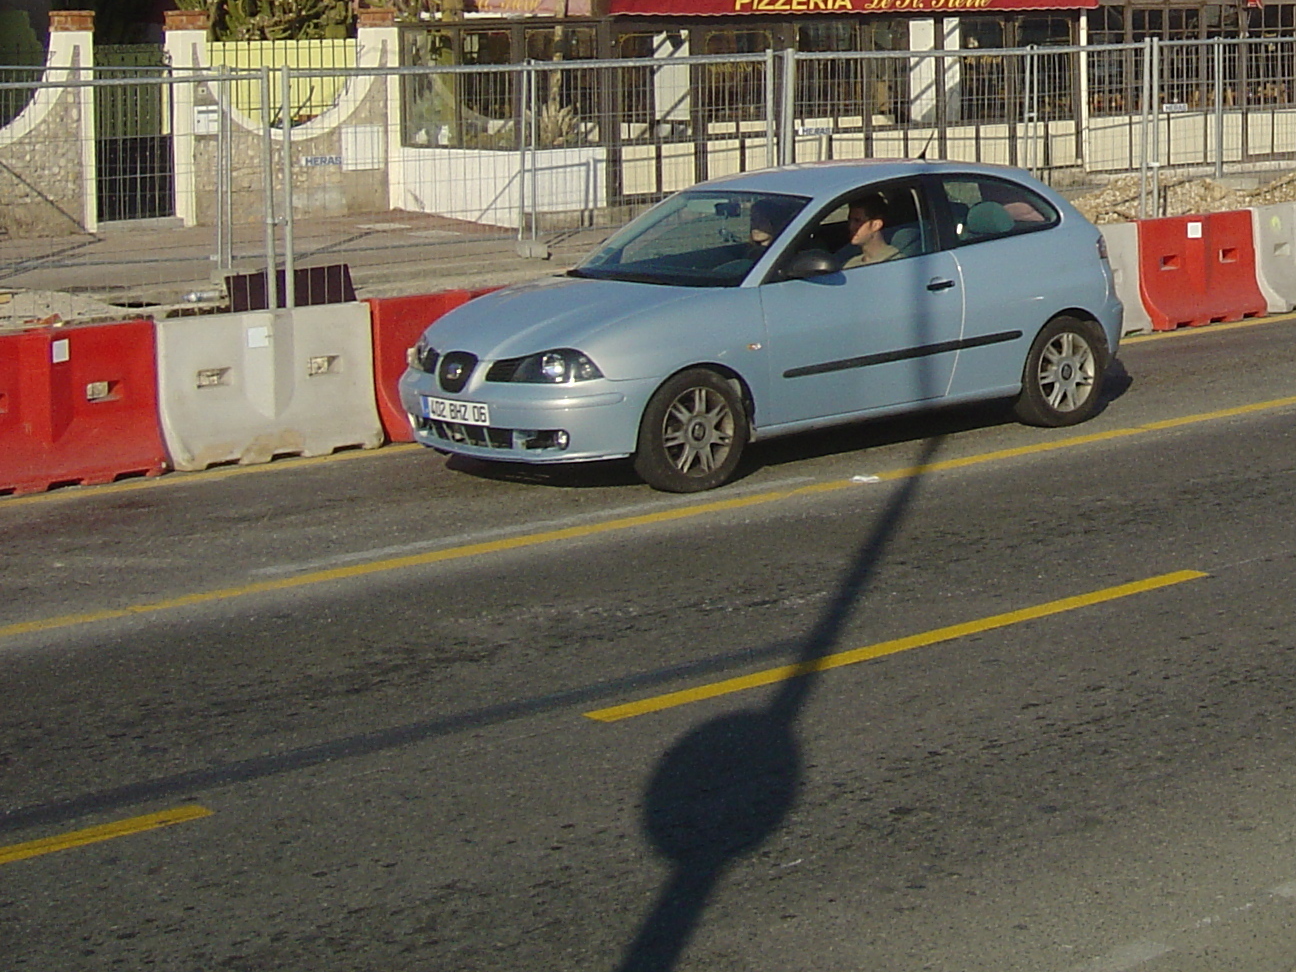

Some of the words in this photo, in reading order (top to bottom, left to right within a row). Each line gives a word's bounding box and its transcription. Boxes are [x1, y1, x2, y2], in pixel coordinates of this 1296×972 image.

[305, 156, 342, 166] HERAS
[430, 400, 447, 418] 402
[449, 403, 469, 422] BHZ
[473, 406, 488, 423] 06
